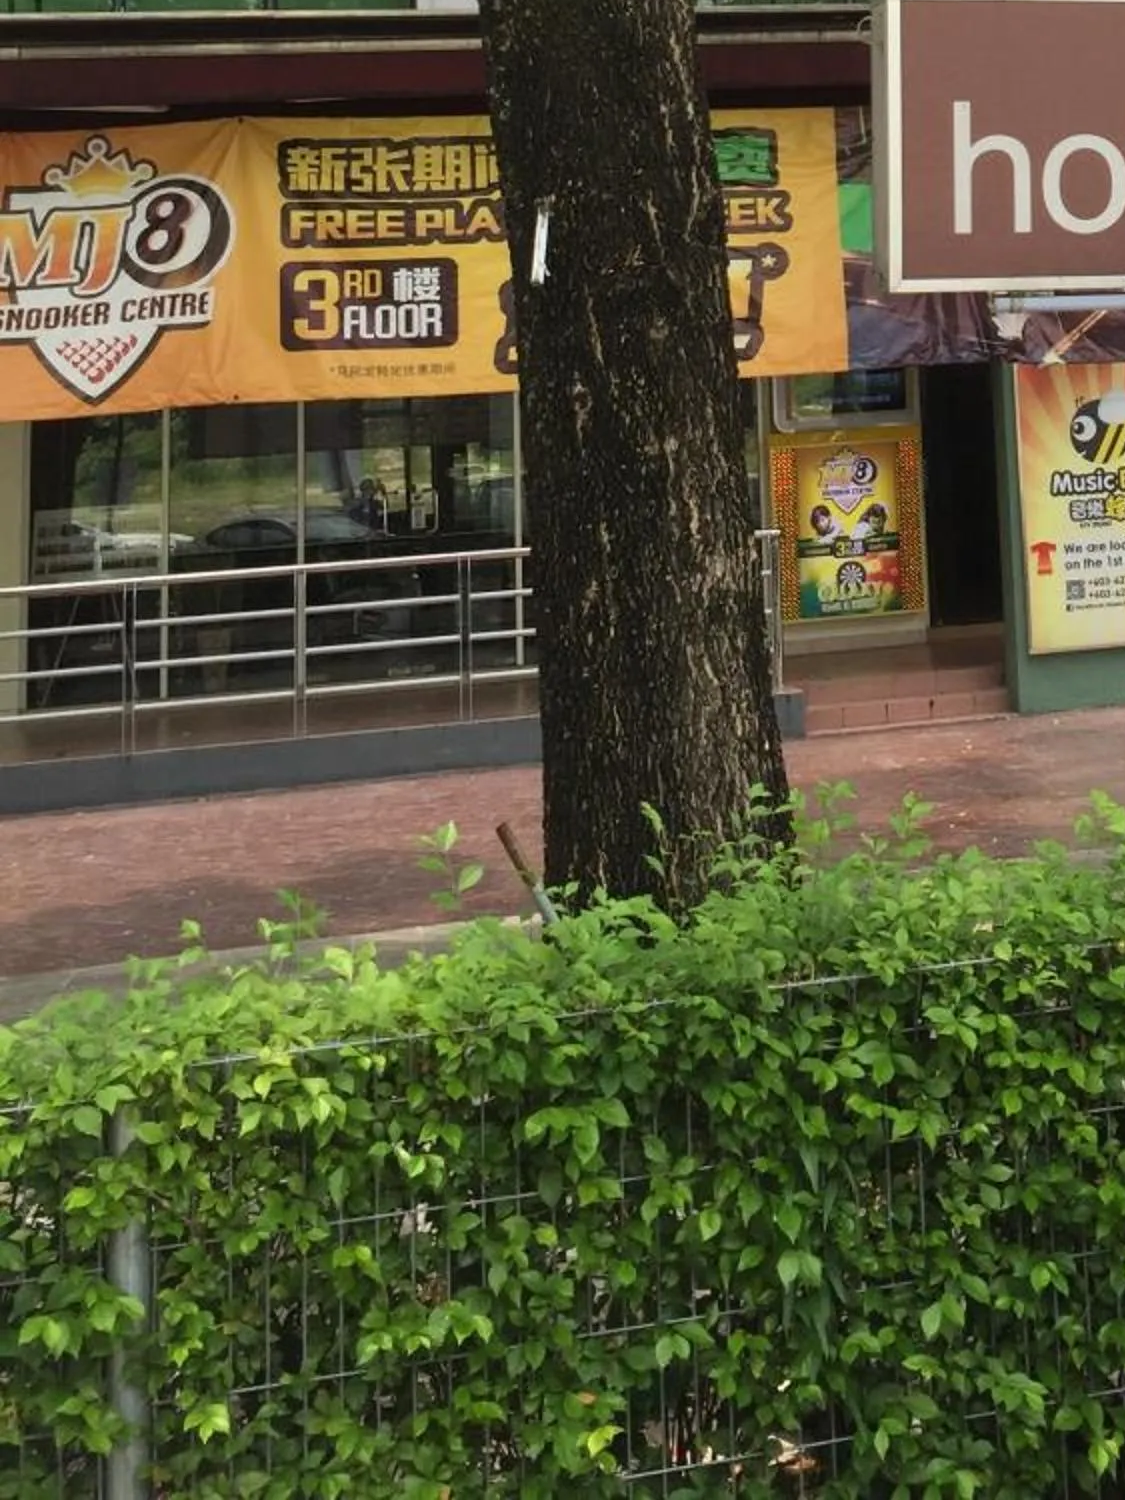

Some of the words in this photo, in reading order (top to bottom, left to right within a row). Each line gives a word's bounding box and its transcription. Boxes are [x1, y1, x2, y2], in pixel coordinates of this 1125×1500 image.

[289, 209, 405, 241] FREE
[415, 205, 502, 237] PLA
[392, 267, 441, 302] 楼
[120, 291, 210, 323] CENTRE
[343, 303, 443, 340] FLOOR
[1052, 469, 1116, 495] Music
[1064, 542, 1083, 554] We
[1086, 542, 1106, 553] are
[1064, 560, 1081, 571] on
[1083, 557, 1103, 570] the
[1107, 555, 1123, 567] 1st
